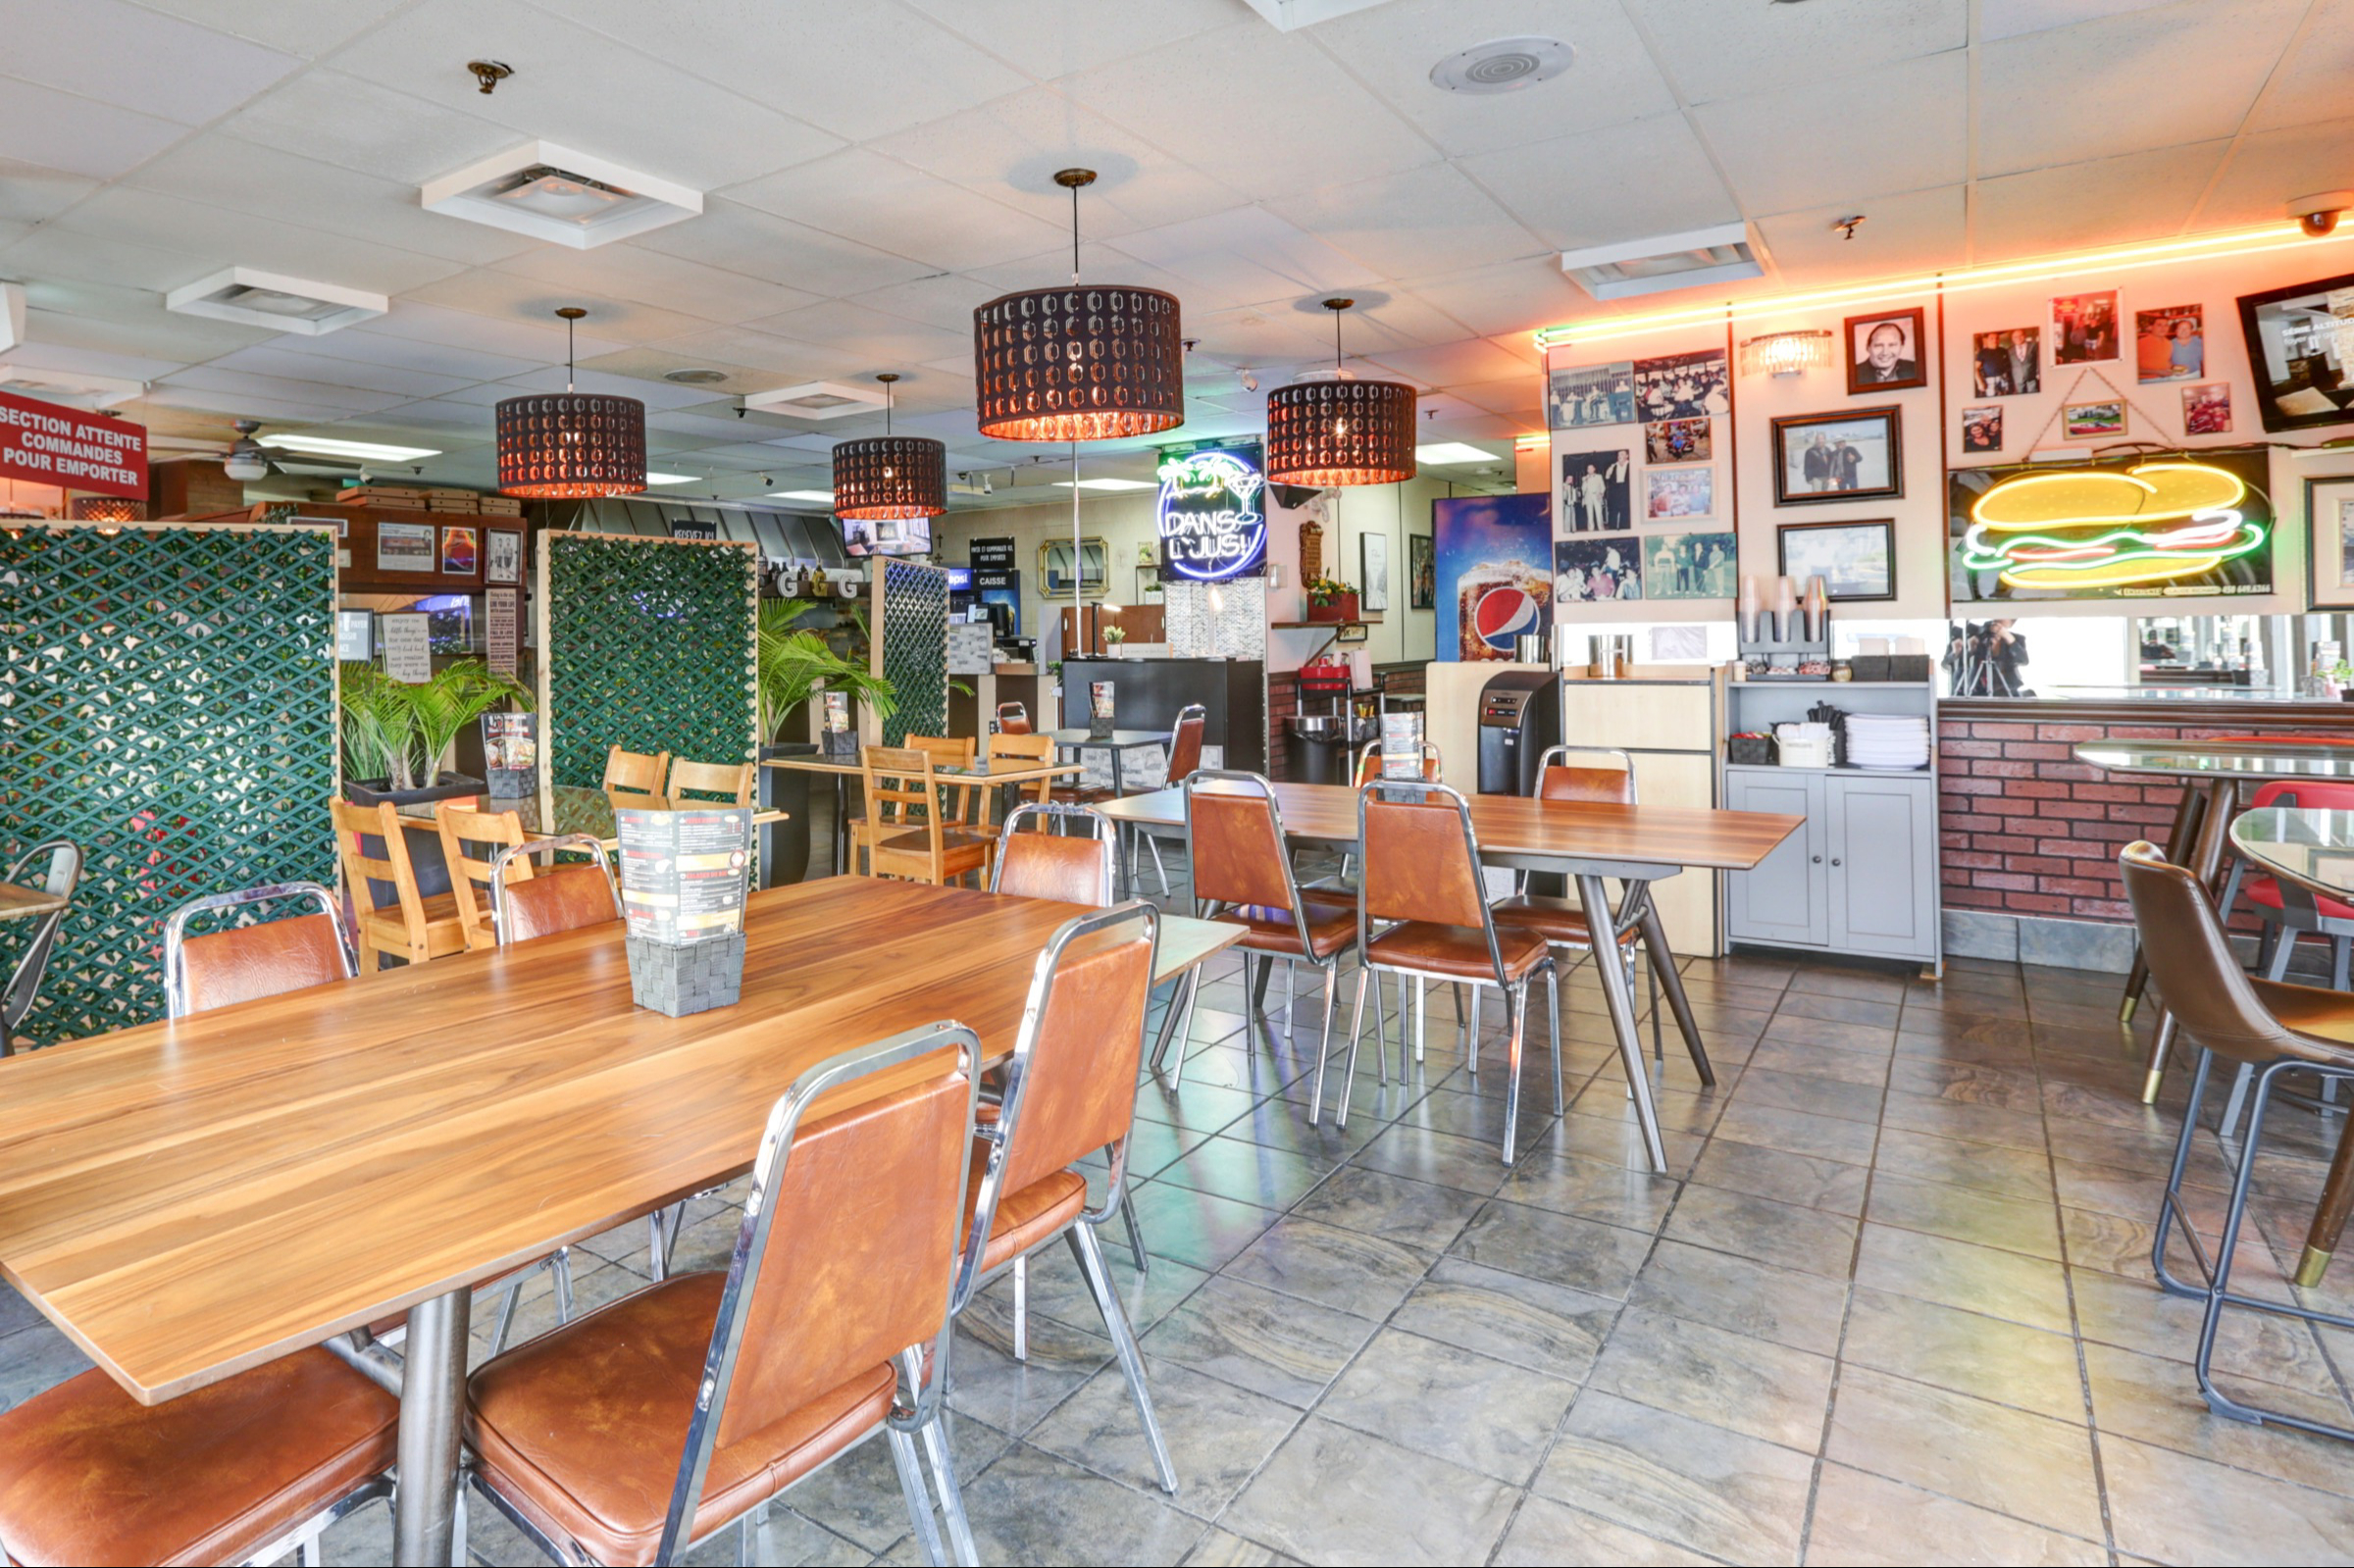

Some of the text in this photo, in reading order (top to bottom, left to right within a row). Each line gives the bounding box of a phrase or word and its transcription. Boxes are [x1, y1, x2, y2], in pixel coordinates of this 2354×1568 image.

[0, 406, 142, 451] SECTION ATTENTE
[22, 431, 124, 466] COMMANDES
[3, 447, 138, 486] POUR EMPORTER
[1164, 510, 1237, 536] DANS
[777, 571, 858, 599] G G G
[948, 573, 968, 586] epsi
[979, 577, 1006, 585] CAISSE
